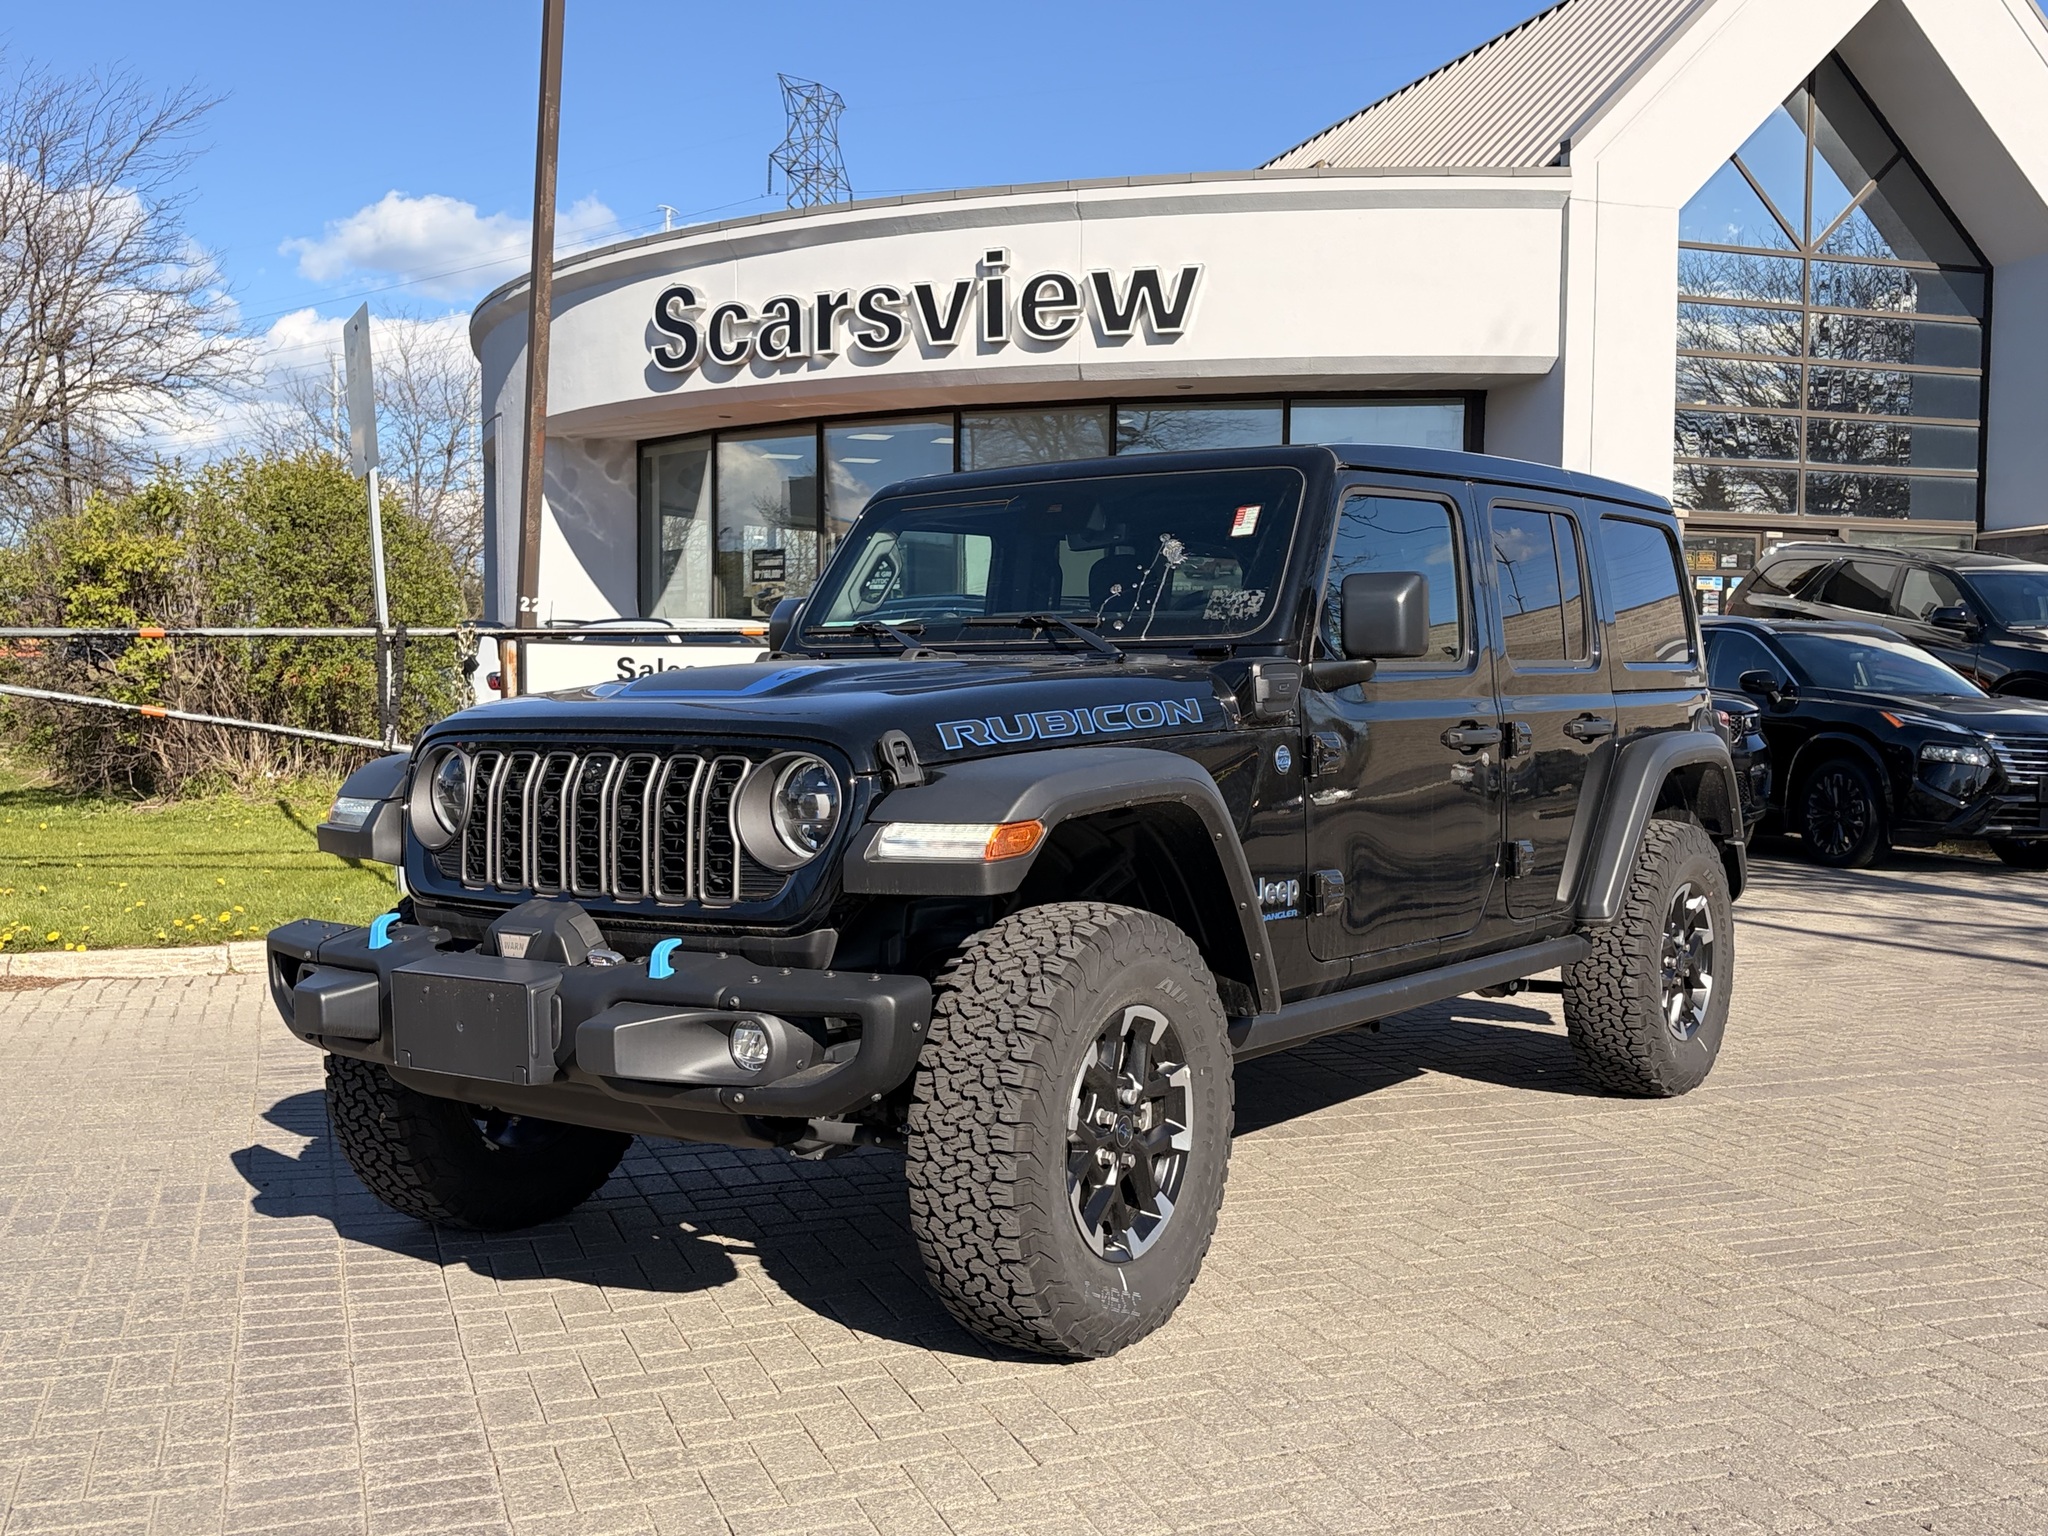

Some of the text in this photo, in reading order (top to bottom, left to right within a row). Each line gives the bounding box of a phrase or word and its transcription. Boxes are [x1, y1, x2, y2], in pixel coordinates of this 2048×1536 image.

[651, 247, 1204, 373] Scarsview
[617, 657, 695, 681] Sal
[936, 698, 1203, 751] RUBICON
[1257, 877, 1300, 907] Jeep
[504, 941, 525, 951] WARN
